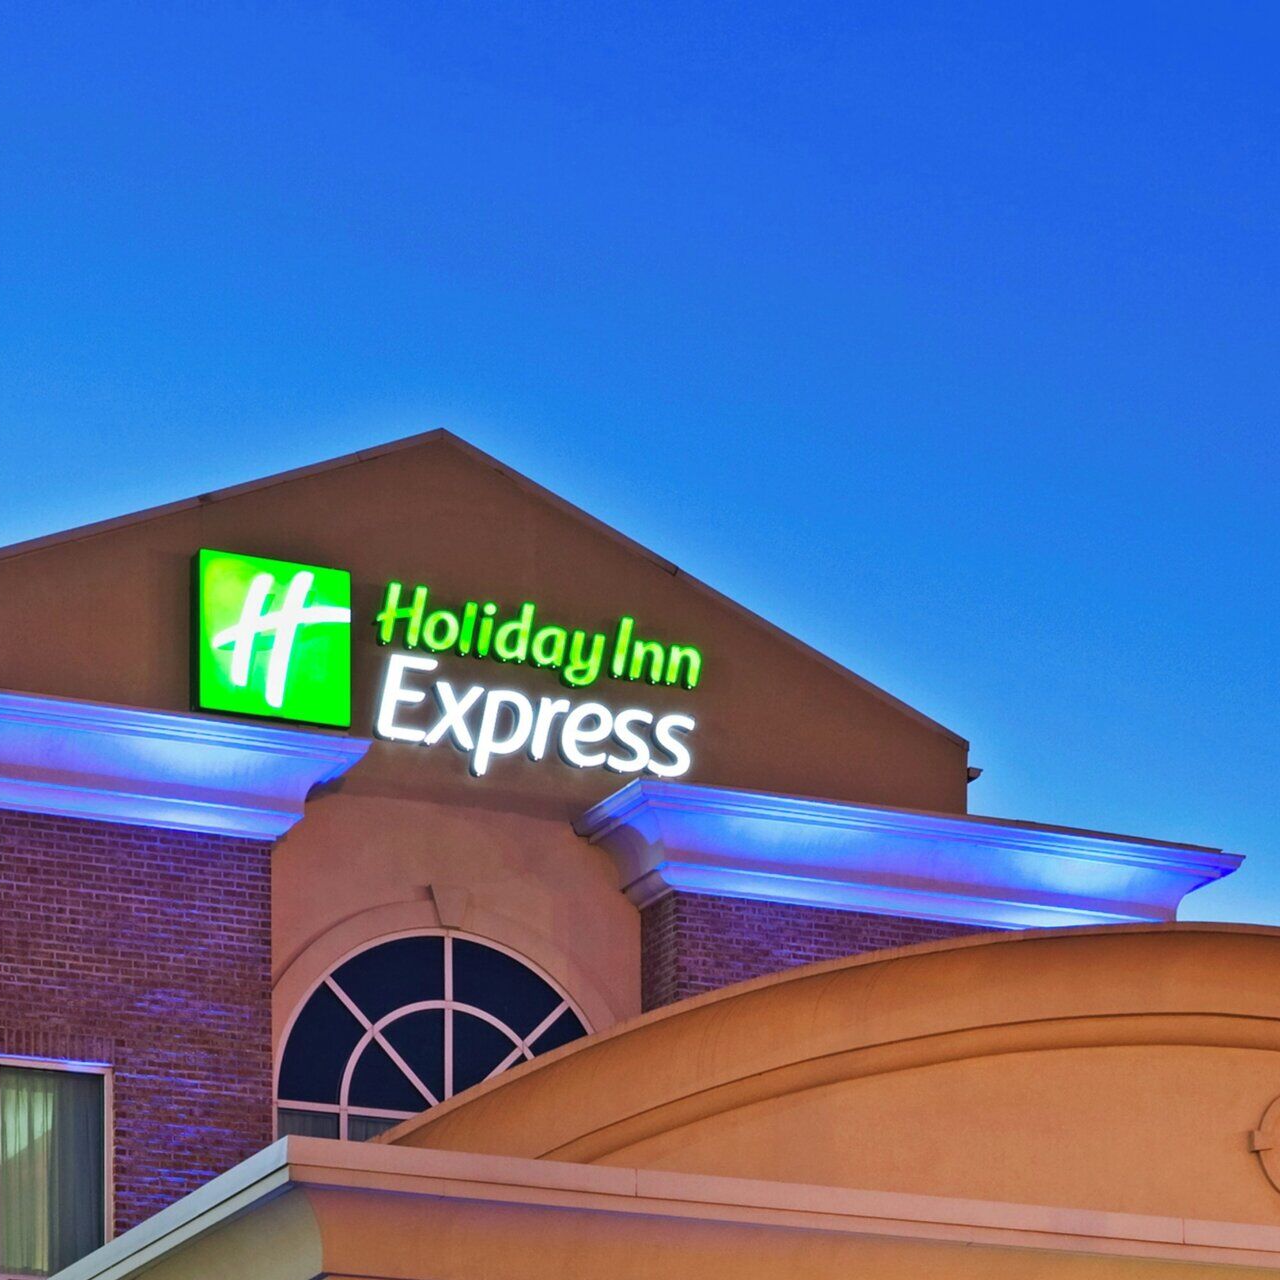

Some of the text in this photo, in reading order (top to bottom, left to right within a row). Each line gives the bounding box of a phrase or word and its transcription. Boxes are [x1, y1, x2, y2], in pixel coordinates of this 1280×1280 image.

[376, 581, 702, 688] Holiday Inn
[376, 653, 696, 778] Express
